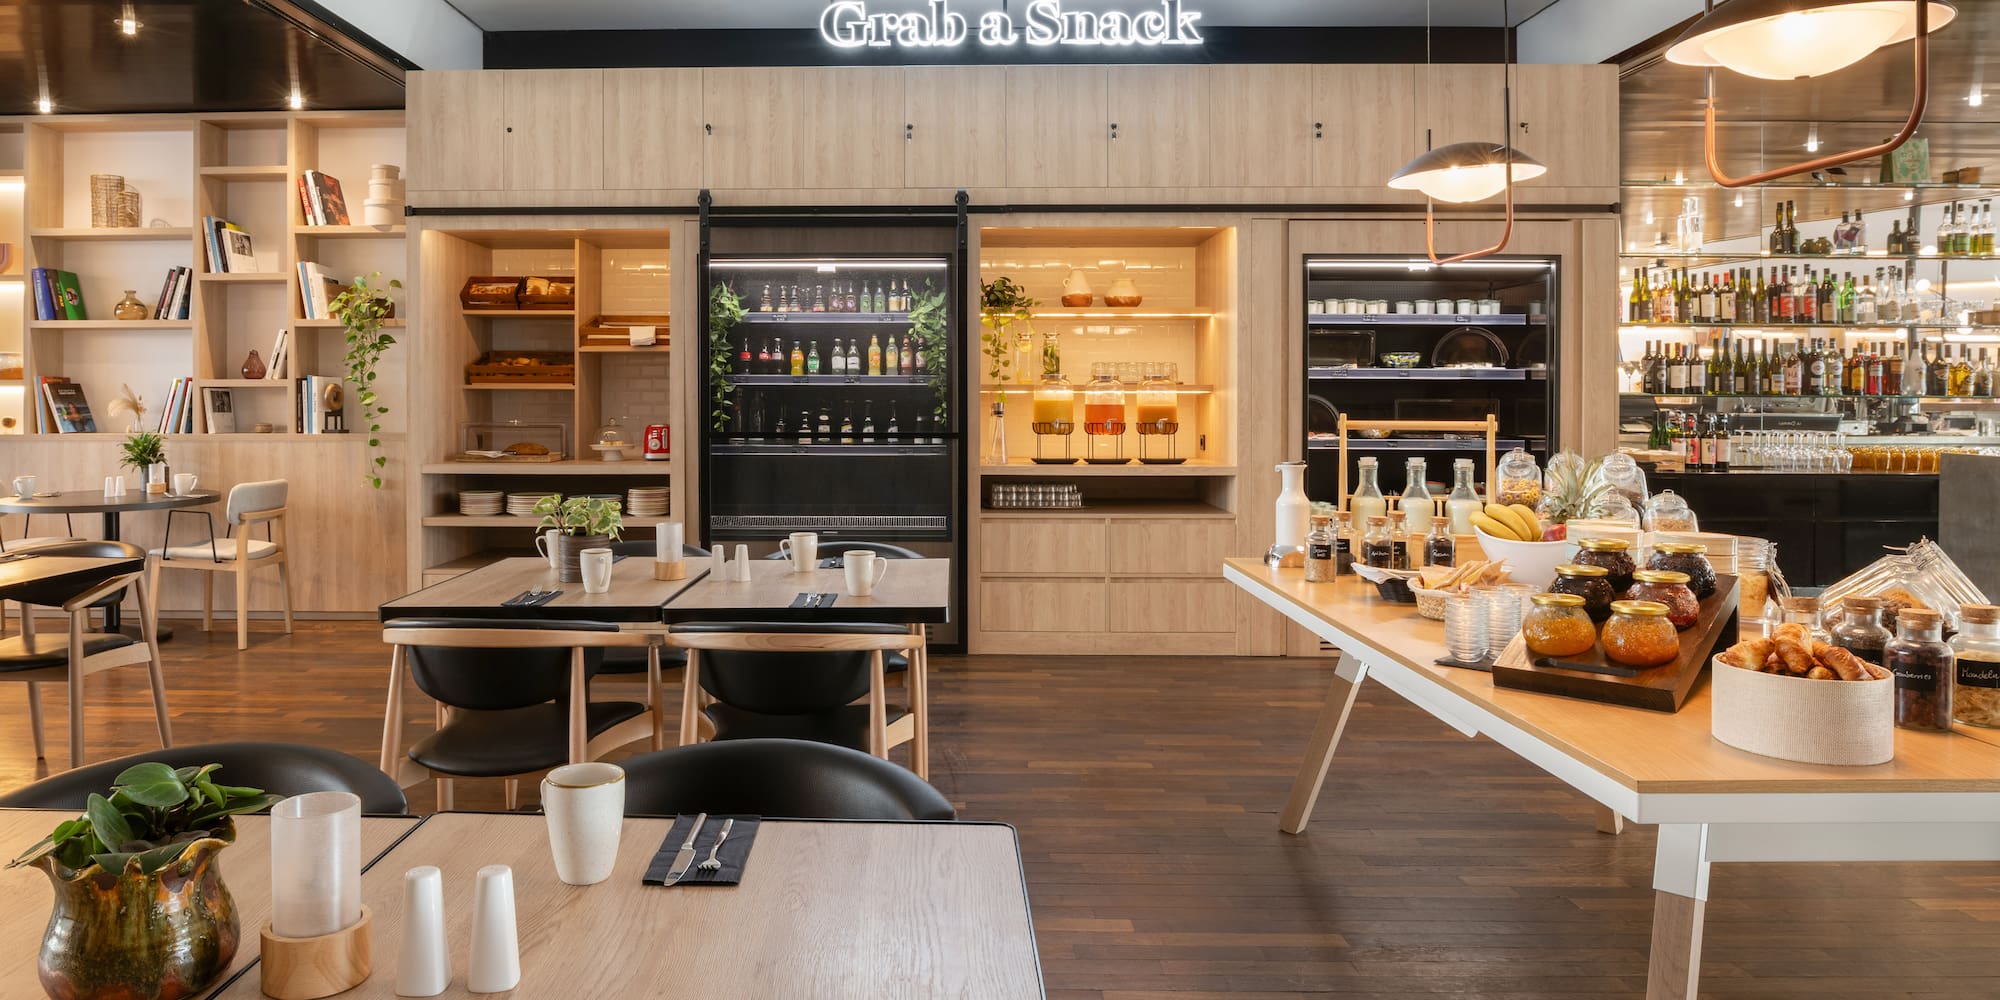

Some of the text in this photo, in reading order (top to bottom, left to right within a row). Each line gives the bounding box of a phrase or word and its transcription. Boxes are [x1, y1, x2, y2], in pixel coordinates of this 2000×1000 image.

[820, 0, 1204, 47] Grab a Snack
